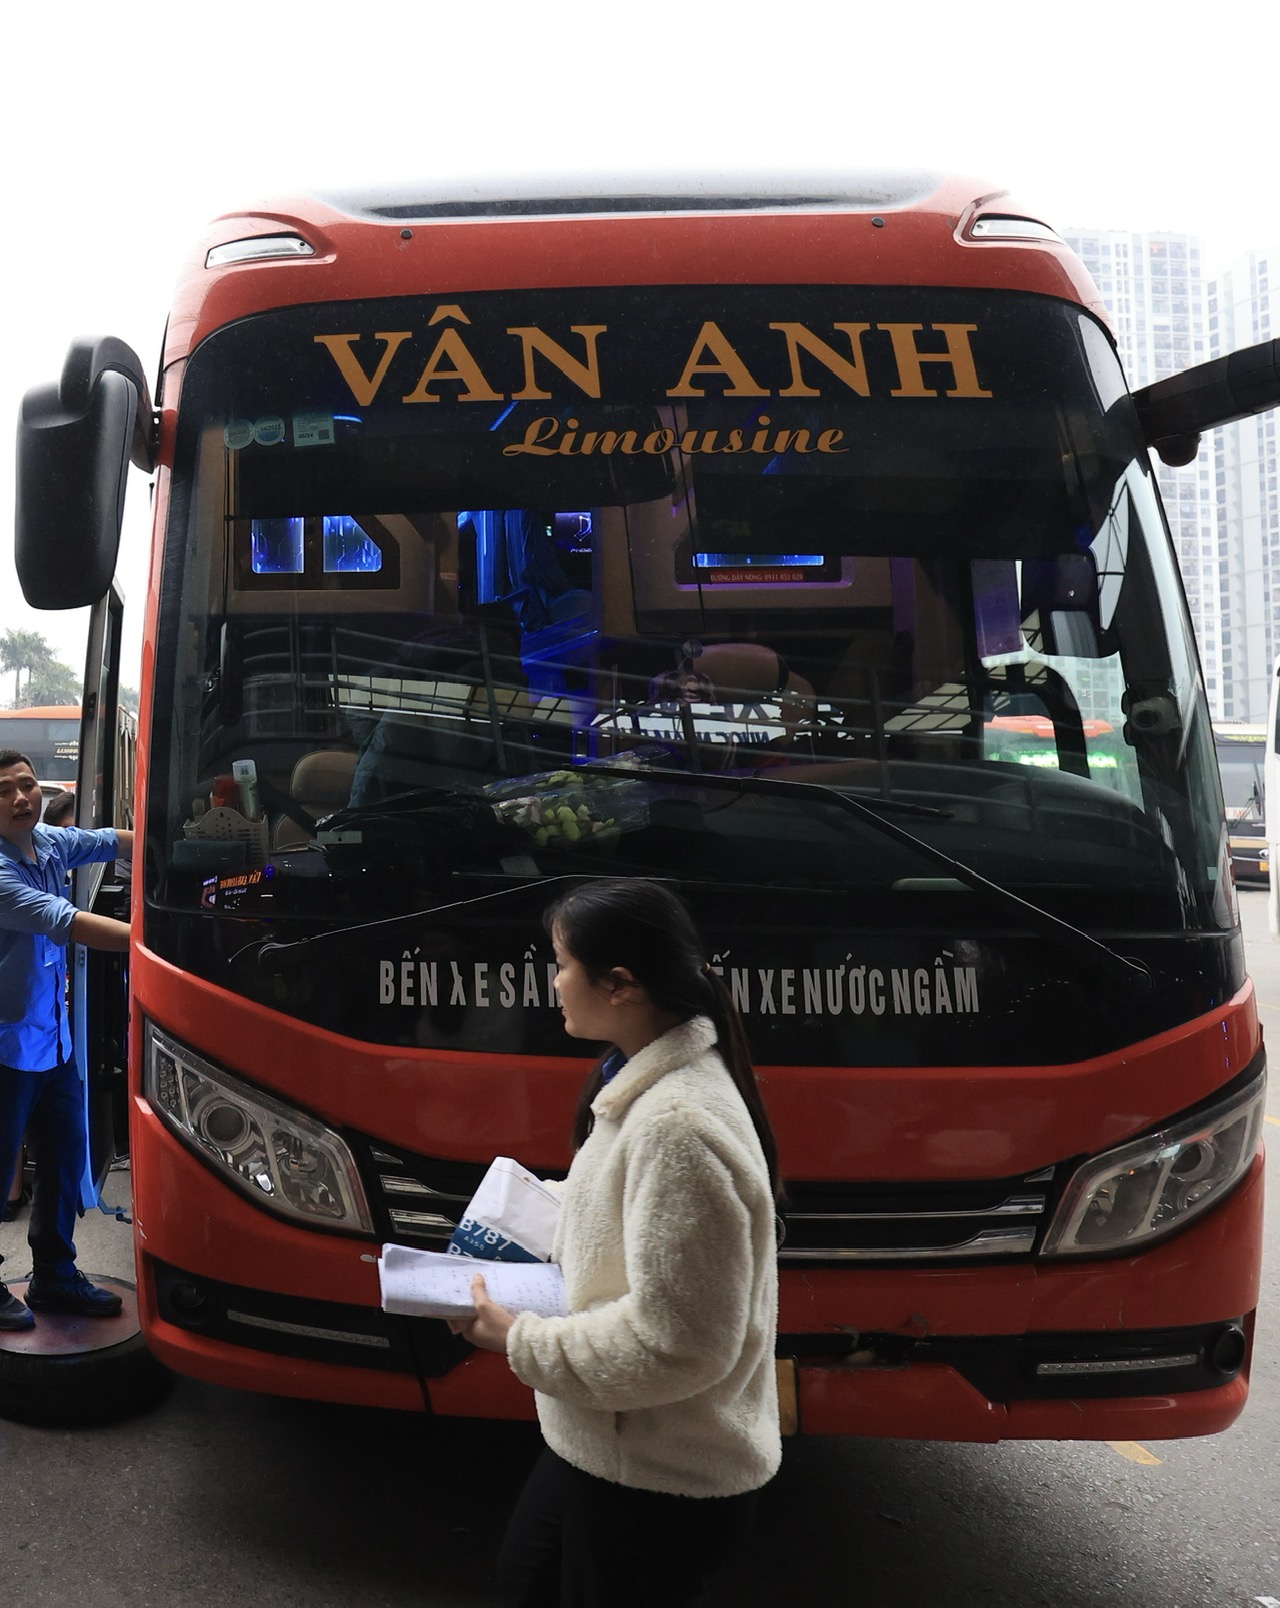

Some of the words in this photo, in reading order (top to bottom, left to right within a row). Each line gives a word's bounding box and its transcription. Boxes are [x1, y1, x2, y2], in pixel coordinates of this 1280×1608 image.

[314, 305, 607, 406] VÂN
[666, 321, 992, 398] ANH
[502, 416, 849, 457] Limousine
[379, 946, 438, 1006] BẾN
[450, 961, 489, 1008] XE
[758, 968, 796, 1015] XE
[803, 952, 886, 1016] NƯỚC
[891, 949, 980, 1016] NGẦM
[459, 1217, 512, 1251] B787
